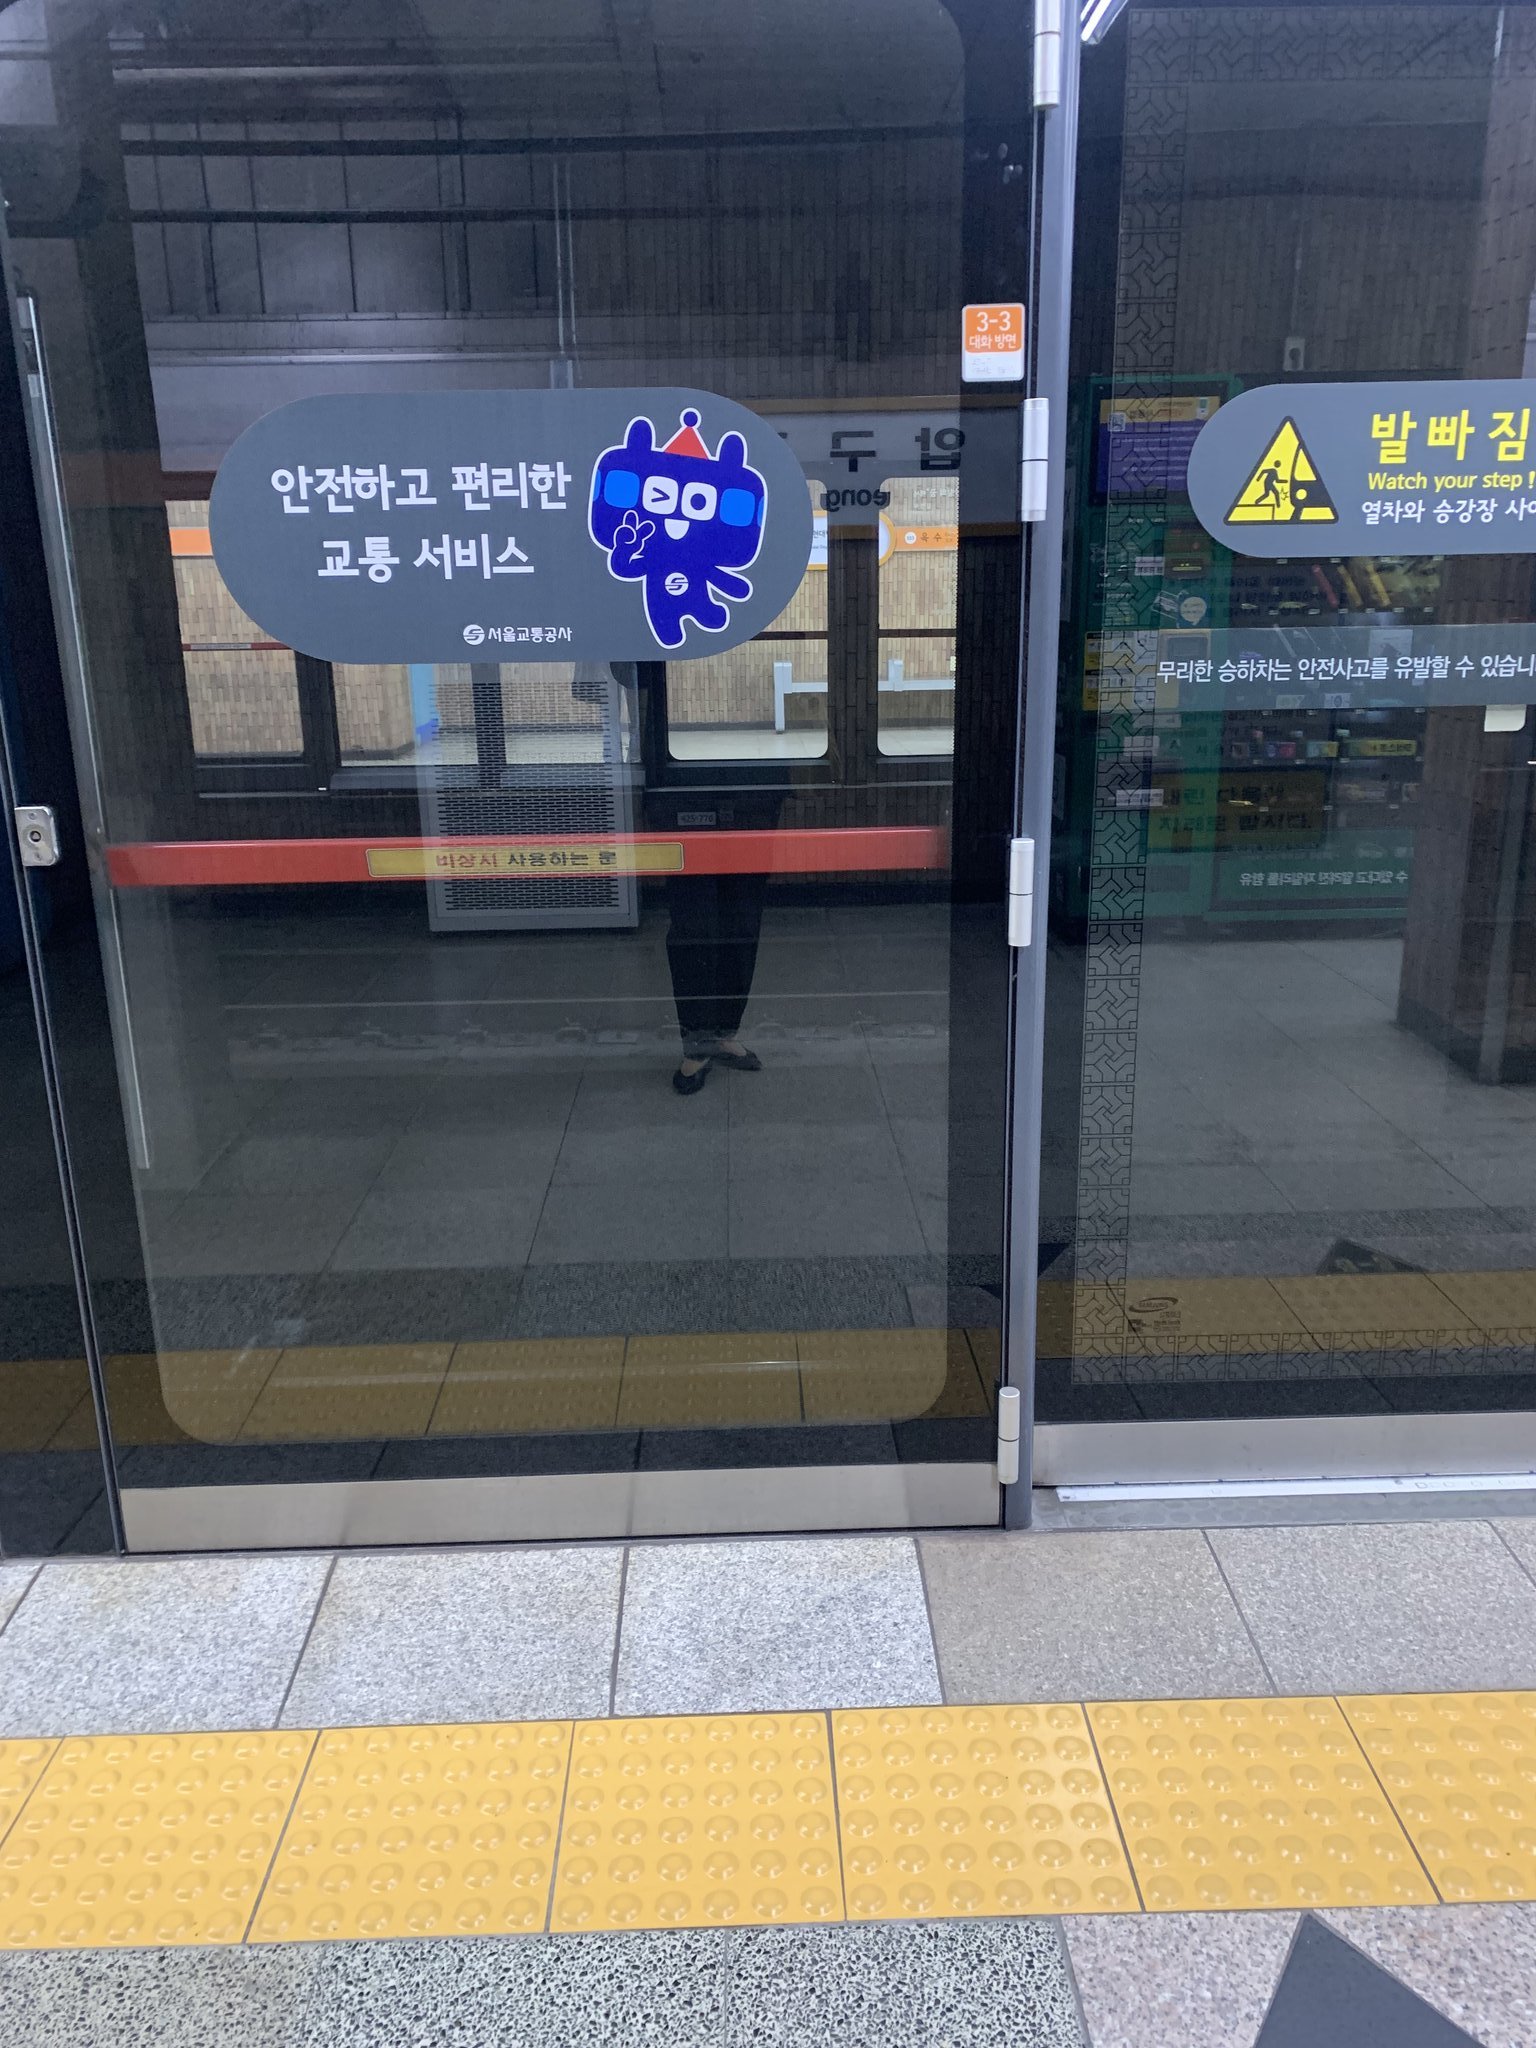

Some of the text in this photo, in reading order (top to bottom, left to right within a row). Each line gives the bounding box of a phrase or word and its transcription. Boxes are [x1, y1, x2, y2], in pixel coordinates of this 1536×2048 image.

[976, 310, 1011, 332] 3-3
[969, 334, 1016, 349] 대화 방면
[270, 461, 573, 514] 안전하고 편리한
[1368, 472, 1427, 490] Watch
[1434, 475, 1476, 493] your
[1483, 473, 1523, 491] step
[1361, 499, 1426, 525] 열차와
[1432, 497, 1499, 524] 승강장
[317, 533, 535, 584] 교통 서비스
[487, 626, 573, 643] 서울교통공사
[1156, 653, 1536, 684] 무리한 승하차는 안전사고를 유발할 수 있습니
[436, 852, 498, 869] 비상시
[507, 850, 589, 868] 사용하는
